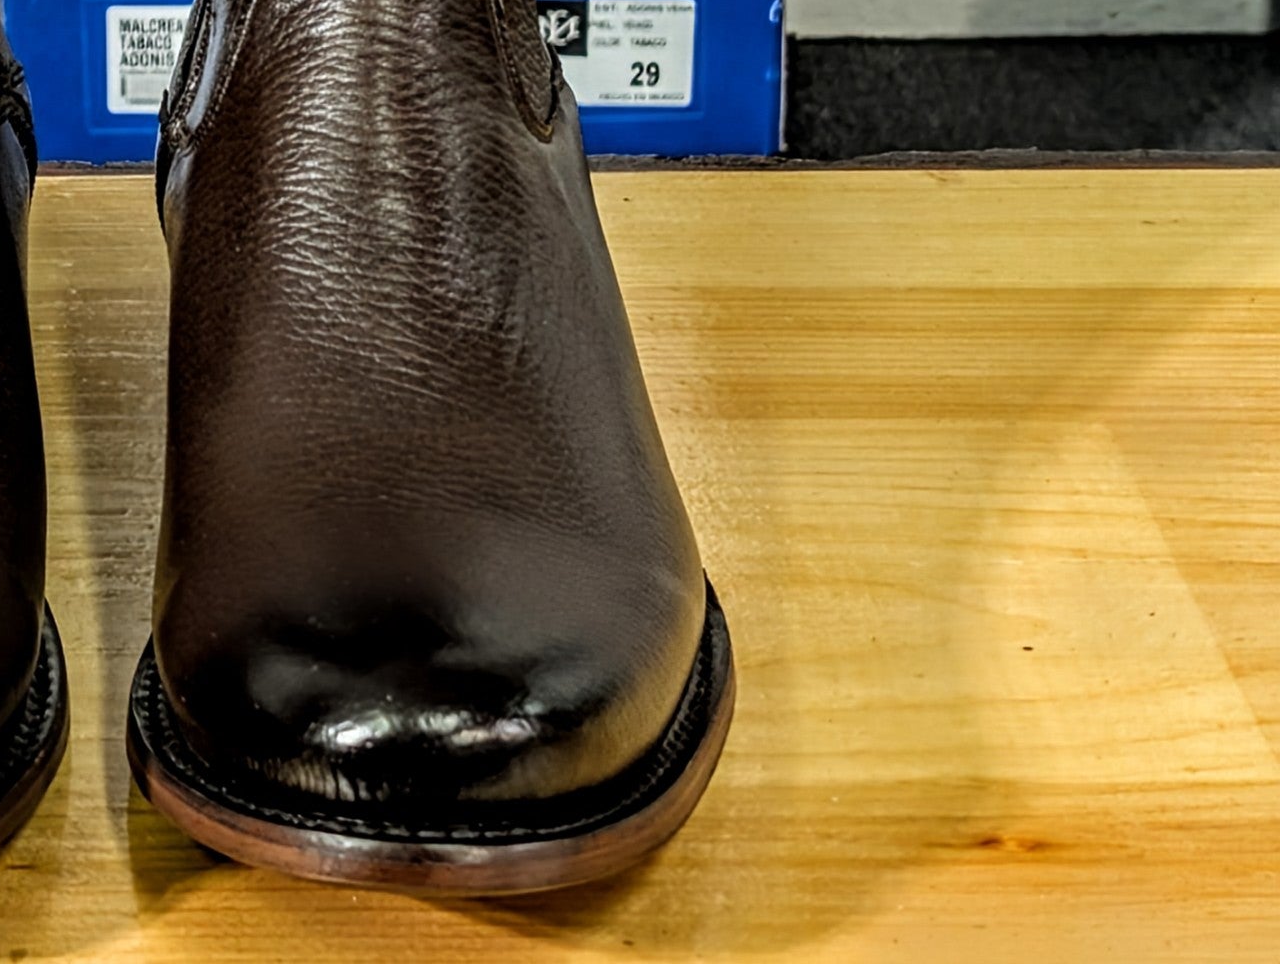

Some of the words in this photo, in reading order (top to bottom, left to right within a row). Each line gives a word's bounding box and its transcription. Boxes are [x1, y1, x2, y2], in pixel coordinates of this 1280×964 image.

[119, 18, 184, 33] MALCREA
[120, 34, 172, 50] TABACO
[120, 50, 175, 67] ADONIS
[630, 61, 660, 87] 29
